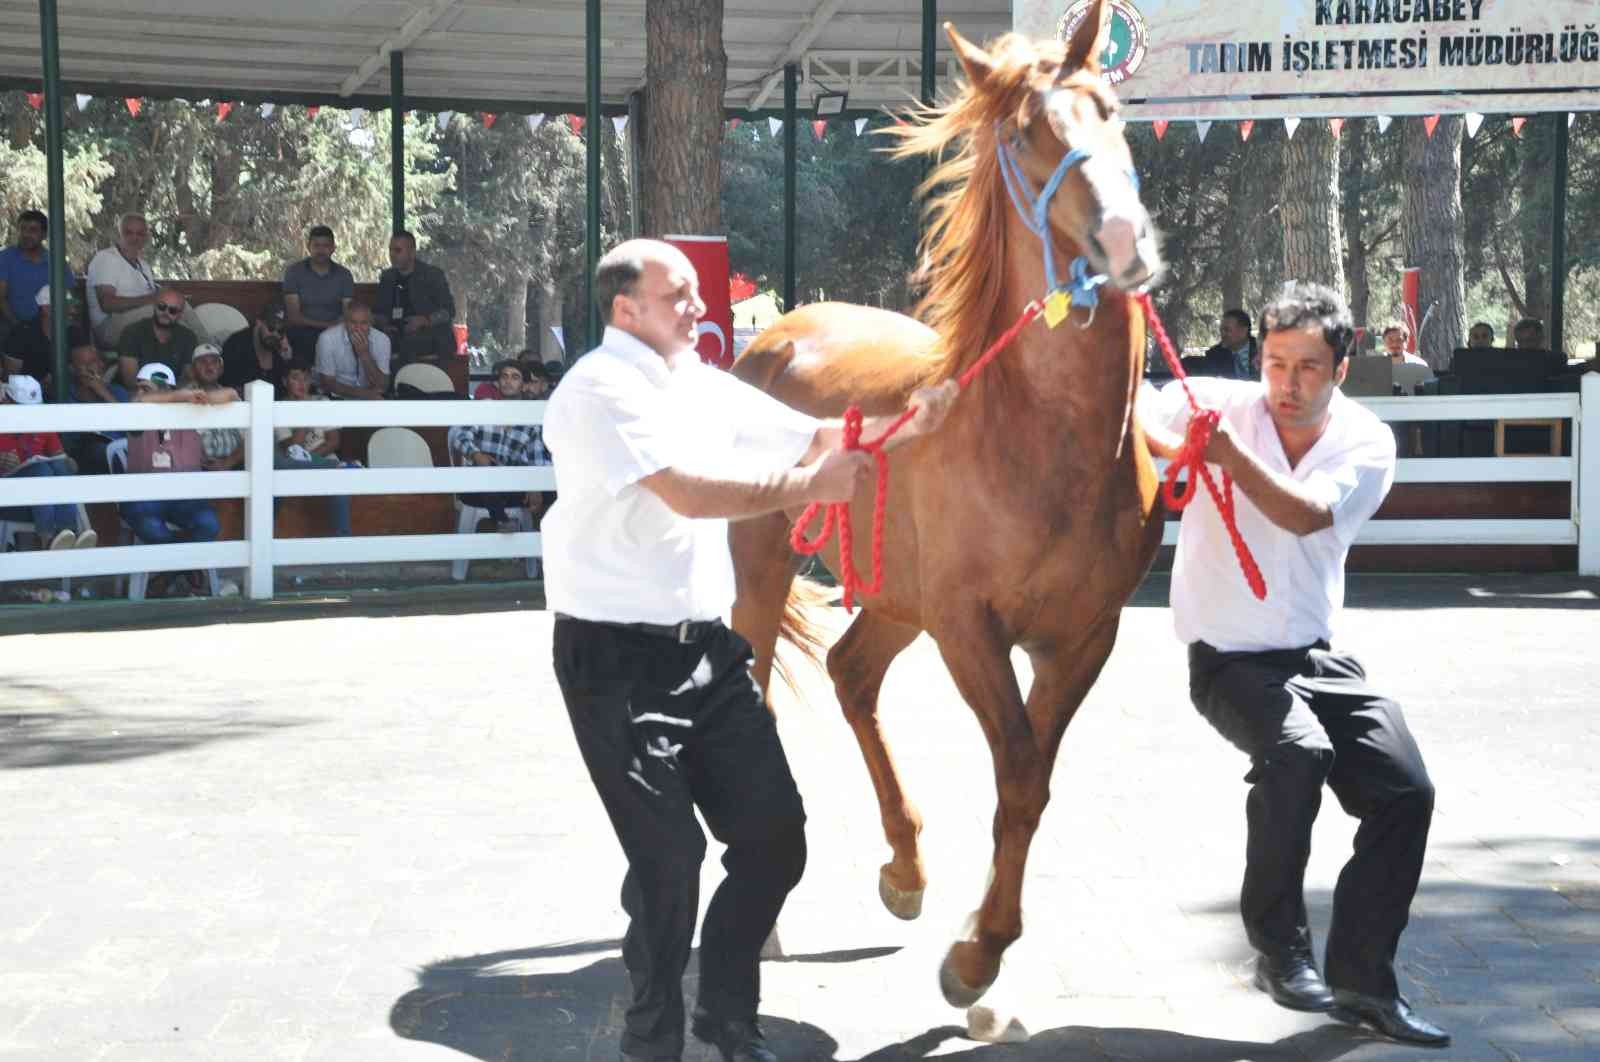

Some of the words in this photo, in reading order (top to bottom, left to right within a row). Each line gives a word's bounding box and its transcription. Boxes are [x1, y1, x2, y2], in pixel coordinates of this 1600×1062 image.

[1315, 0, 1483, 25] KARACABEY
[1185, 41, 1272, 74] TARIM
[1282, 30, 1428, 78] İŞLETMESİ
[1439, 23, 1600, 67] MÜDÜRLÜĞ
